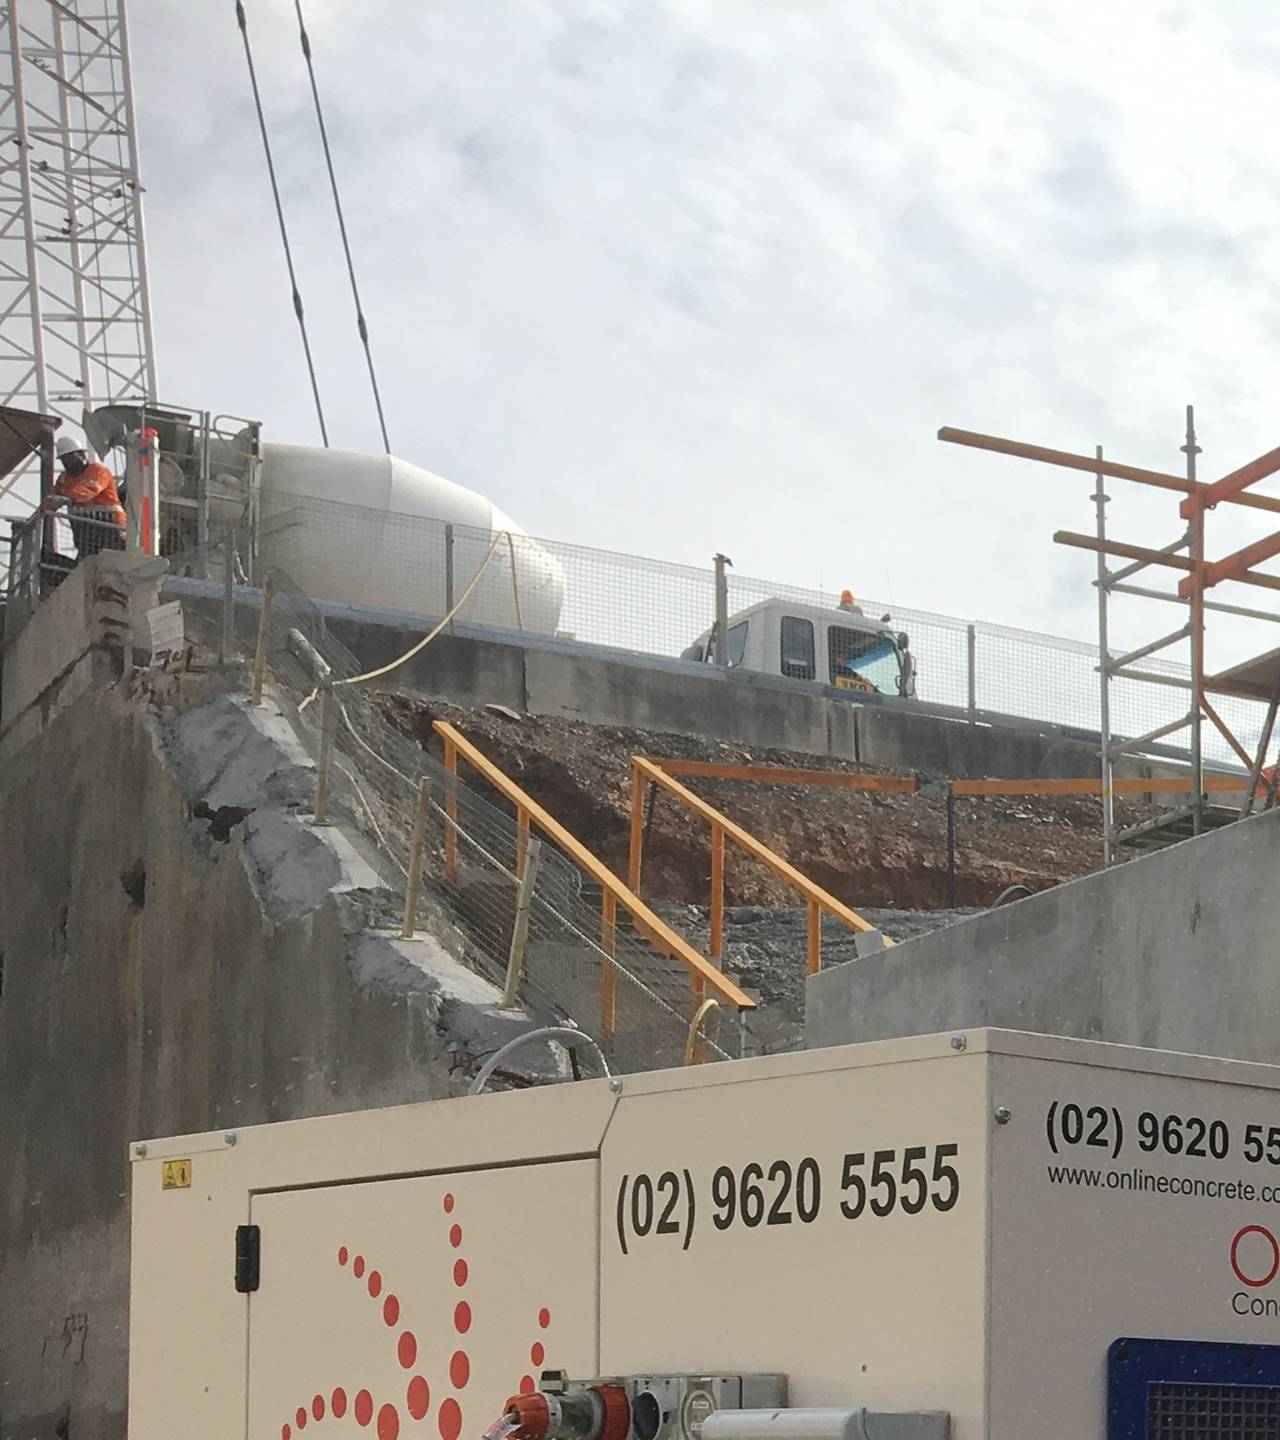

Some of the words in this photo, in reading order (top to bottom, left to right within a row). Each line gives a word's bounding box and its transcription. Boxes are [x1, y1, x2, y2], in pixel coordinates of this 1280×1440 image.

[1046, 1101, 1123, 1159] (02)
[1138, 1112, 1229, 1159] 9620
[617, 1169, 695, 1254] (02)
[712, 1157, 821, 1230] 9620
[840, 1143, 959, 1219] 5555
